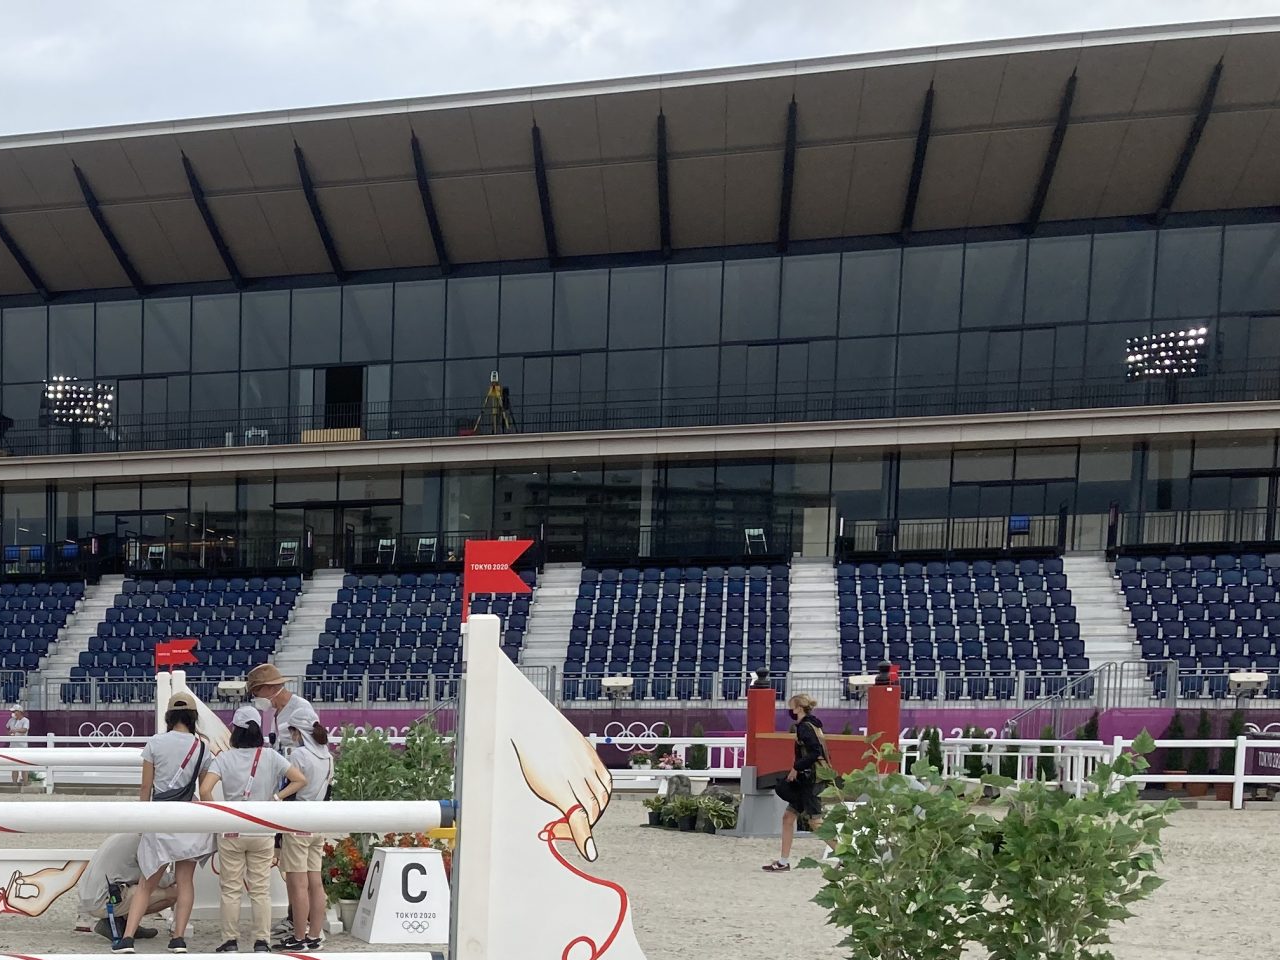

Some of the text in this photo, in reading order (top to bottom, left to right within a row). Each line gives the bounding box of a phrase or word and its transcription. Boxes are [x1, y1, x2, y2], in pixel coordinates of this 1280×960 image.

[471, 563, 509, 571] TOKYO 2020
[368, 860, 380, 900] C
[401, 862, 427, 904] C
[395, 911, 437, 919] TOKYO 2020
